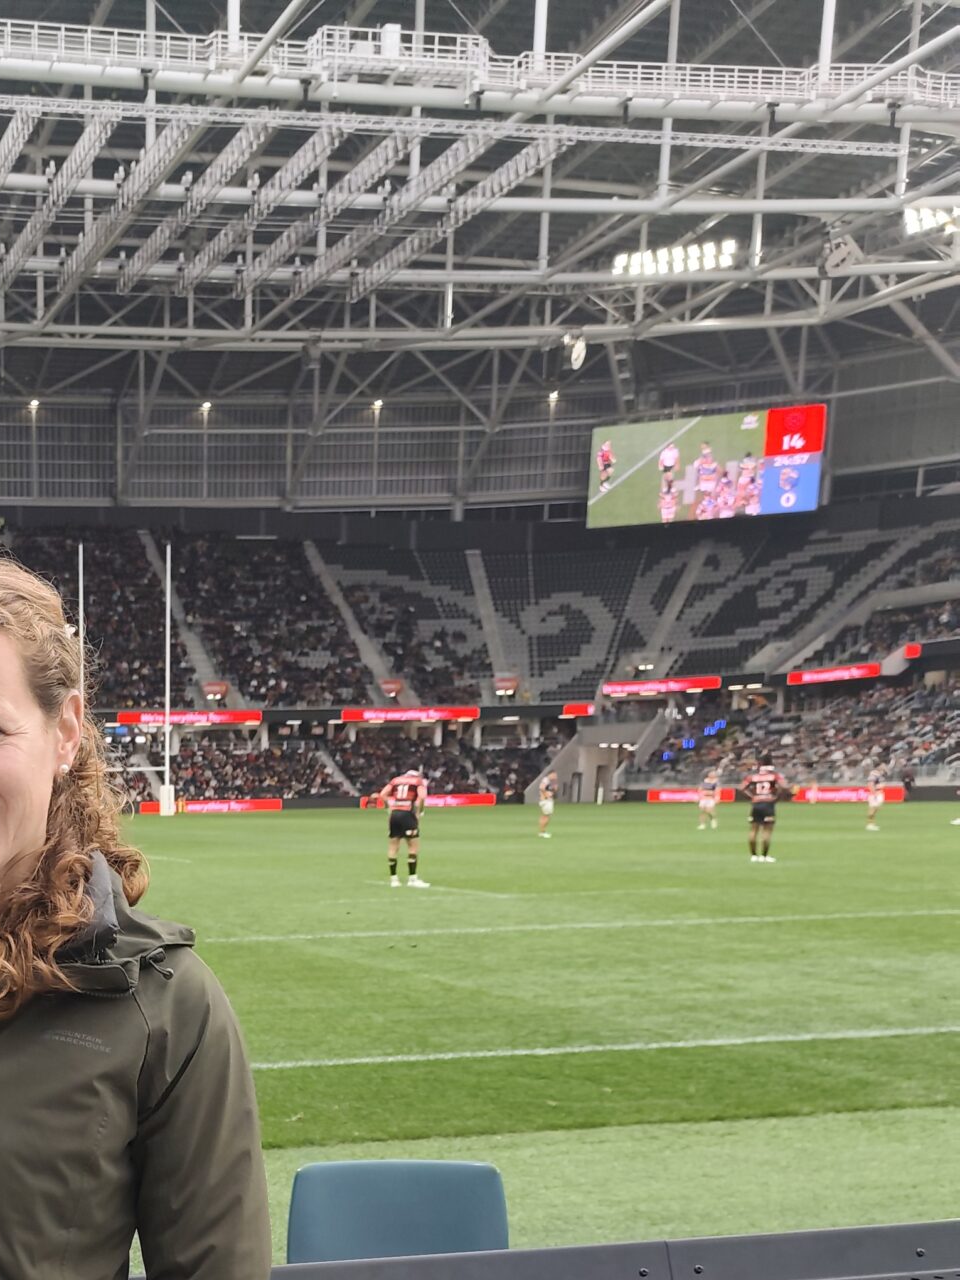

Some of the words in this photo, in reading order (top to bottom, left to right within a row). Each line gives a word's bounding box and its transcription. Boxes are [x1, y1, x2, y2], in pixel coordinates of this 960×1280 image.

[782, 433, 807, 451] 14
[780, 492, 797, 508] 0
[51, 1035, 112, 1054] WAREHOUSE
